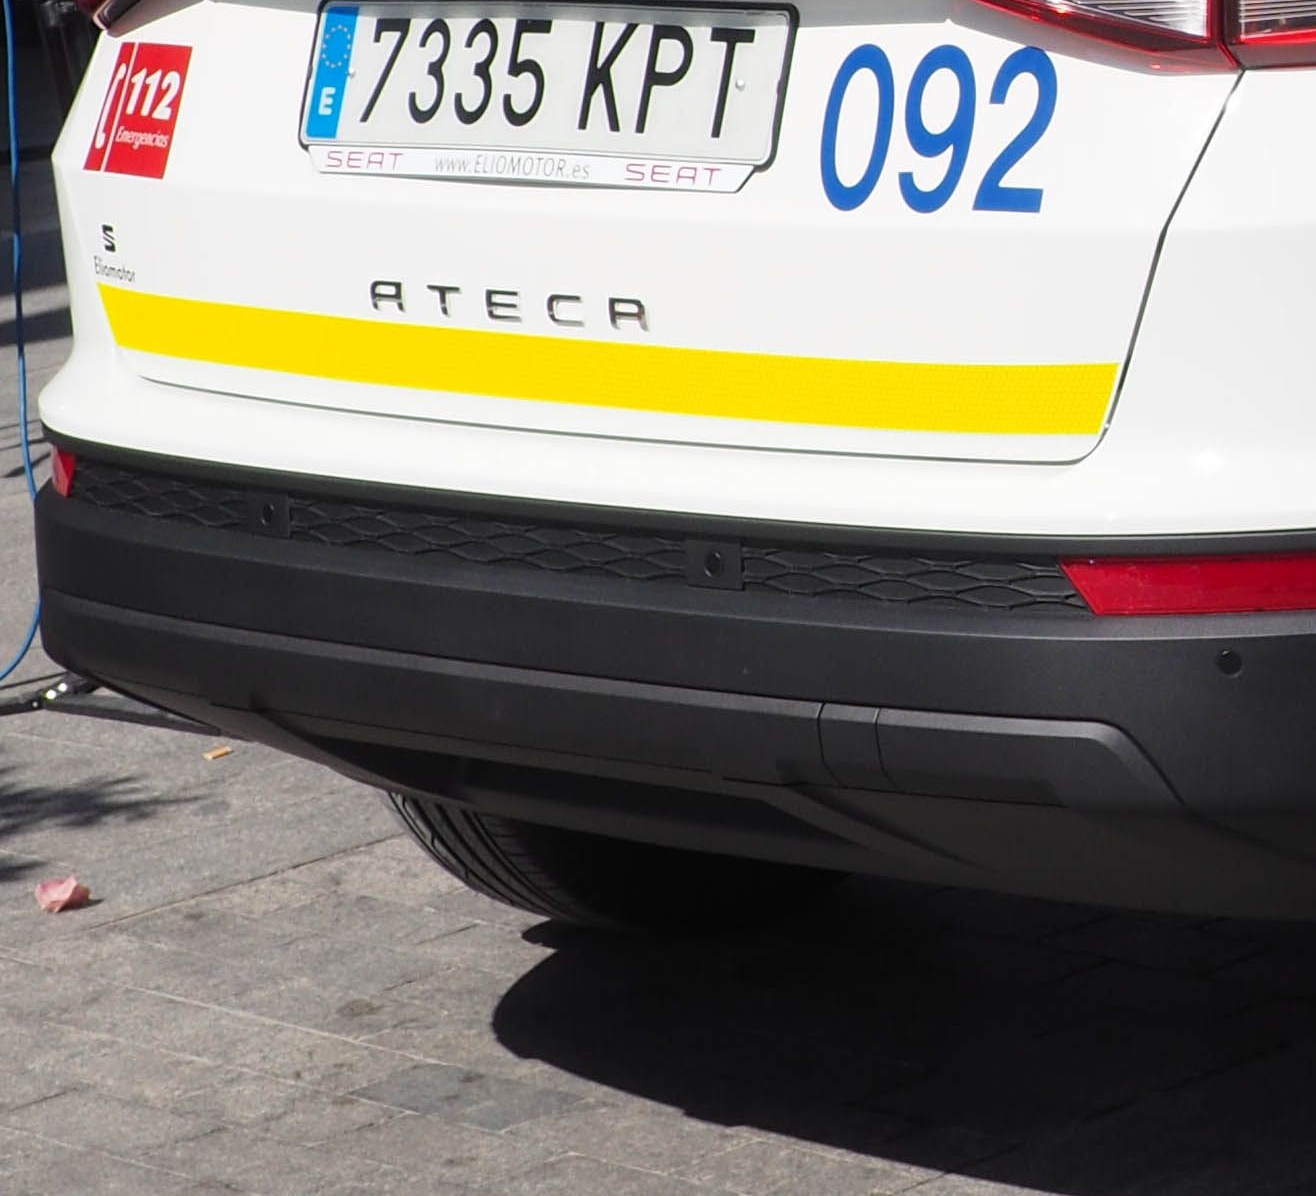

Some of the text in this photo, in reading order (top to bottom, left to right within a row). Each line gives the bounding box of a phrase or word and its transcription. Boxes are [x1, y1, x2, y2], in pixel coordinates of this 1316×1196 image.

[125, 68, 181, 121] 112
[317, 86, 336, 117] E
[358, 17, 757, 140] 7335 KPT
[115, 125, 171, 150] Emergencias
[819, 44, 1058, 214] 092
[325, 150, 723, 187] SEAT www.ELIOMOTOR.es SEAT
[369, 280, 650, 331] ATECA
